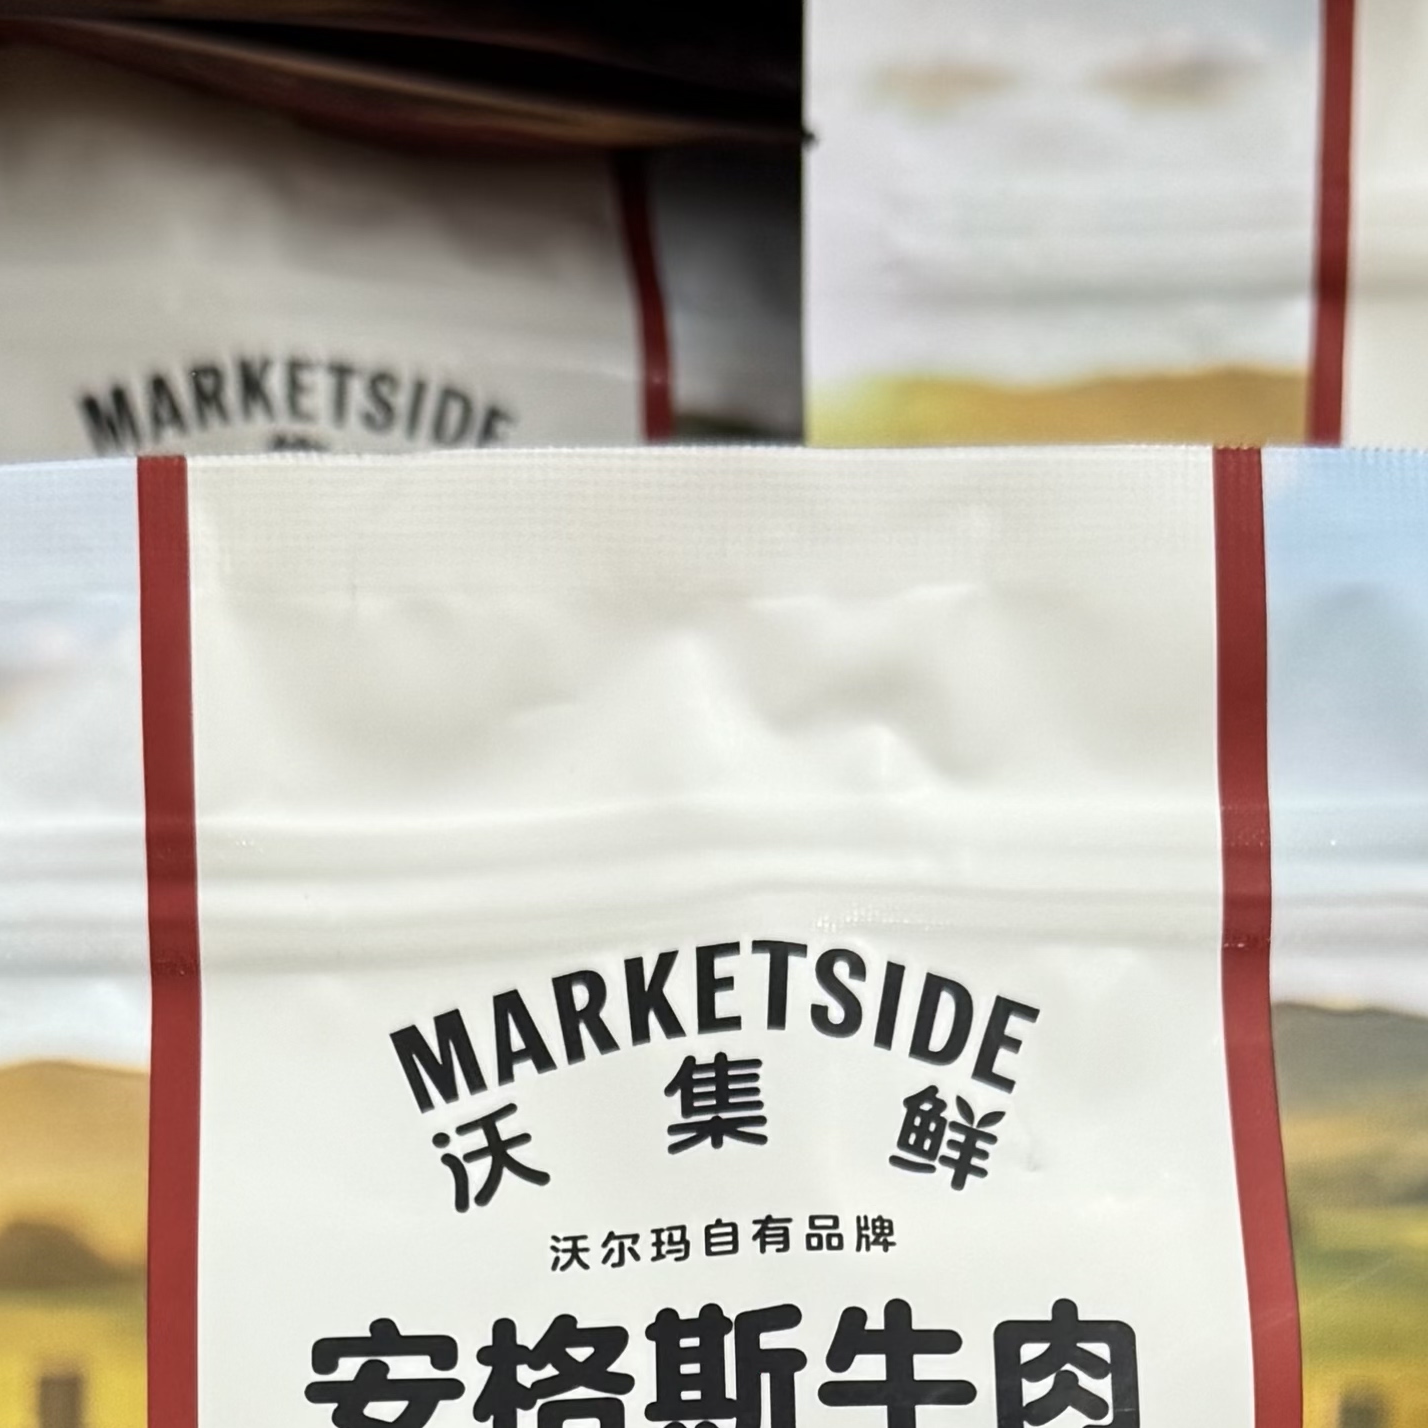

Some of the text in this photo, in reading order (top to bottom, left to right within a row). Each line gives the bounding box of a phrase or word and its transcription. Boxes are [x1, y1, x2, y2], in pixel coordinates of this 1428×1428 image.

[80, 355, 516, 452] MARKETSIDE
[389, 939, 1041, 1114] MARKETSIDE
[431, 1051, 1007, 1213] 沃集鲜
[549, 1213, 898, 1273] 沃尔玛自有品牌
